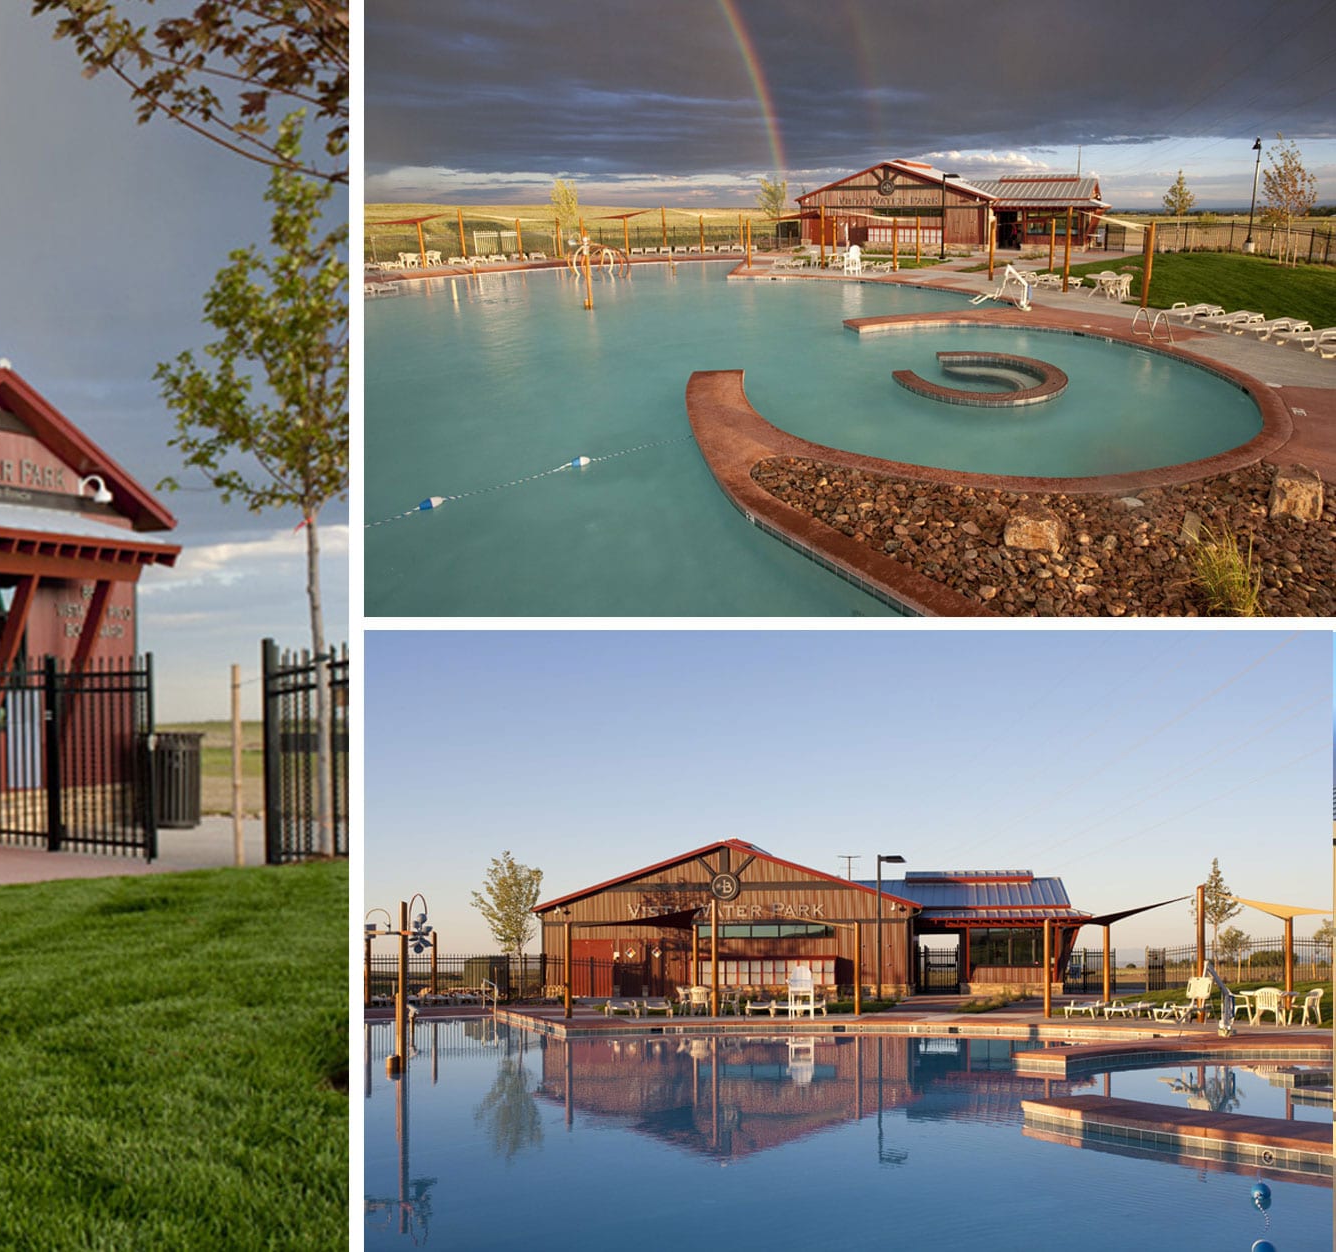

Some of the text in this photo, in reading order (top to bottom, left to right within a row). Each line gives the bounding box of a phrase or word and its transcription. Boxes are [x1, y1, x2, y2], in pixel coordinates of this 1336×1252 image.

[20, 458, 66, 490] PARK
[627, 903, 681, 919] VISTA
[771, 902, 825, 917] PARK
